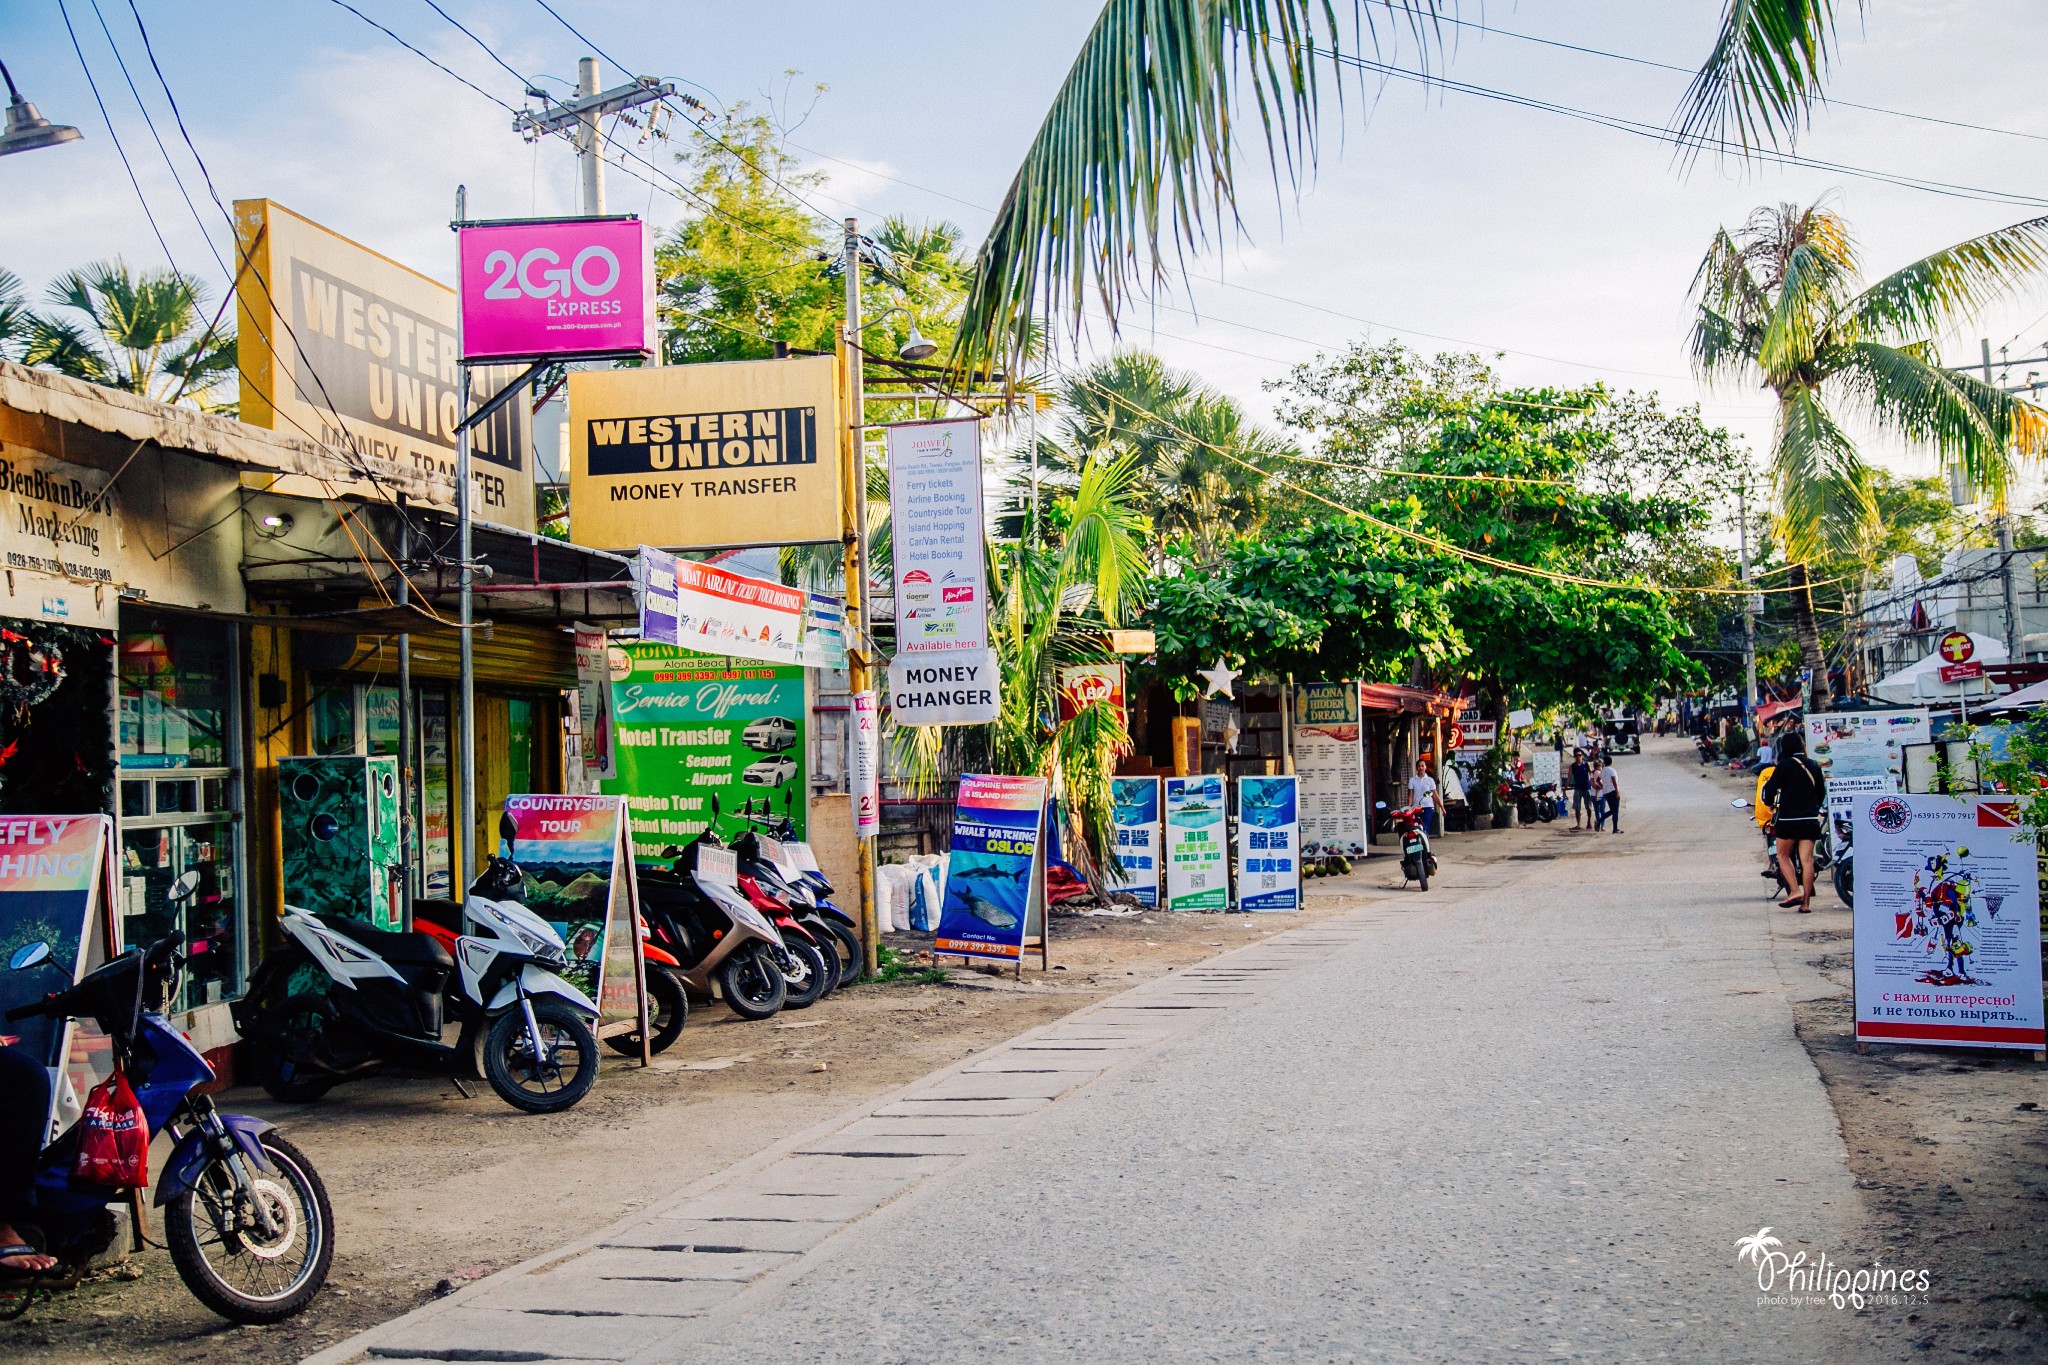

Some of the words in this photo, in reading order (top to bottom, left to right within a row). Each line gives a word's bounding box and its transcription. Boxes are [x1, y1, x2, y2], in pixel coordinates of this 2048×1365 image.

[483, 245, 620, 300] 2GO
[547, 299, 621, 316] EXPRESS
[591, 411, 777, 446] WESTERN
[650, 438, 777, 470] UNION
[610, 482, 684, 501] MONEY
[690, 476, 797, 498] TRANSFER
[907, 481, 926, 491] Ferry
[928, 480, 953, 488] tickets
[908, 495, 931, 504] Airline
[934, 493, 965, 503] Booking
[908, 508, 953, 518] Countryside
[956, 506, 973, 515] Tour
[908, 523, 931, 532] Island
[933, 522, 965, 532] Hopping
[909, 536, 938, 547] Car/Van
[940, 535, 964, 544] Rental
[909, 551, 929, 560] Hotel
[932, 550, 962, 560] Booking
[682, 568, 701, 587] BOAT
[706, 573, 738, 596] AIRLINE
[906, 639, 952, 651] Available
[955, 639, 977, 649] here
[664, 661, 695, 669] Alona
[697, 659, 732, 668] Beach
[736, 658, 764, 666] Road
[654, 671, 674, 682] 0999
[677, 671, 691, 681] 399
[694, 671, 715, 681] 3393
[721, 670, 741, 680] 0997
[744, 670, 756, 679] 111
[758, 669, 775, 679] 7151
[906, 666, 978, 684] MONEY
[896, 689, 992, 708] CHANGER
[1310, 688, 1344, 698] ALONA
[617, 685, 690, 714] Service
[696, 683, 780, 719] Offered:
[1310, 699, 1344, 709] HIDDEN
[1310, 710, 1345, 720] DREAM
[619, 727, 657, 746] Hotel
[660, 726, 731, 746] Transfer
[961, 779, 1001, 790] DOLPHINE
[1001, 782, 1042, 791] WATCHING
[1829, 779, 1882, 787] BoholBikes.ph
[971, 791, 1001, 800] ISLAND
[508, 798, 617, 811] COUNTRYSIDE
[671, 795, 704, 810] Tour
[1914, 812, 1940, 820] +63915
[1957, 812, 1976, 820] 7917
[540, 820, 582, 833] TOUR
[630, 818, 660, 834] sland
[660, 818, 709, 835] Hoping
[954, 825, 985, 838] WHALE
[987, 827, 1036, 842] WATCHING
[986, 840, 1034, 856] OSLOB
[700, 848, 734, 866] MOTORBIKE
[1116, 855, 1152, 869] 火虫
[962, 932, 986, 940] Contact
[949, 940, 969, 949] 0999
[970, 942, 985, 951] 399
[987, 944, 1007, 954] 3393
[1883, 993, 1889, 1001] с
[1894, 993, 1930, 1003] нами
[1935, 994, 2016, 1008] интересно!
[1873, 1006, 1881, 1016] и
[1886, 1007, 1902, 1016] не
[1907, 1007, 1956, 1018] только
[1960, 1008, 2028, 1023] нырять...
